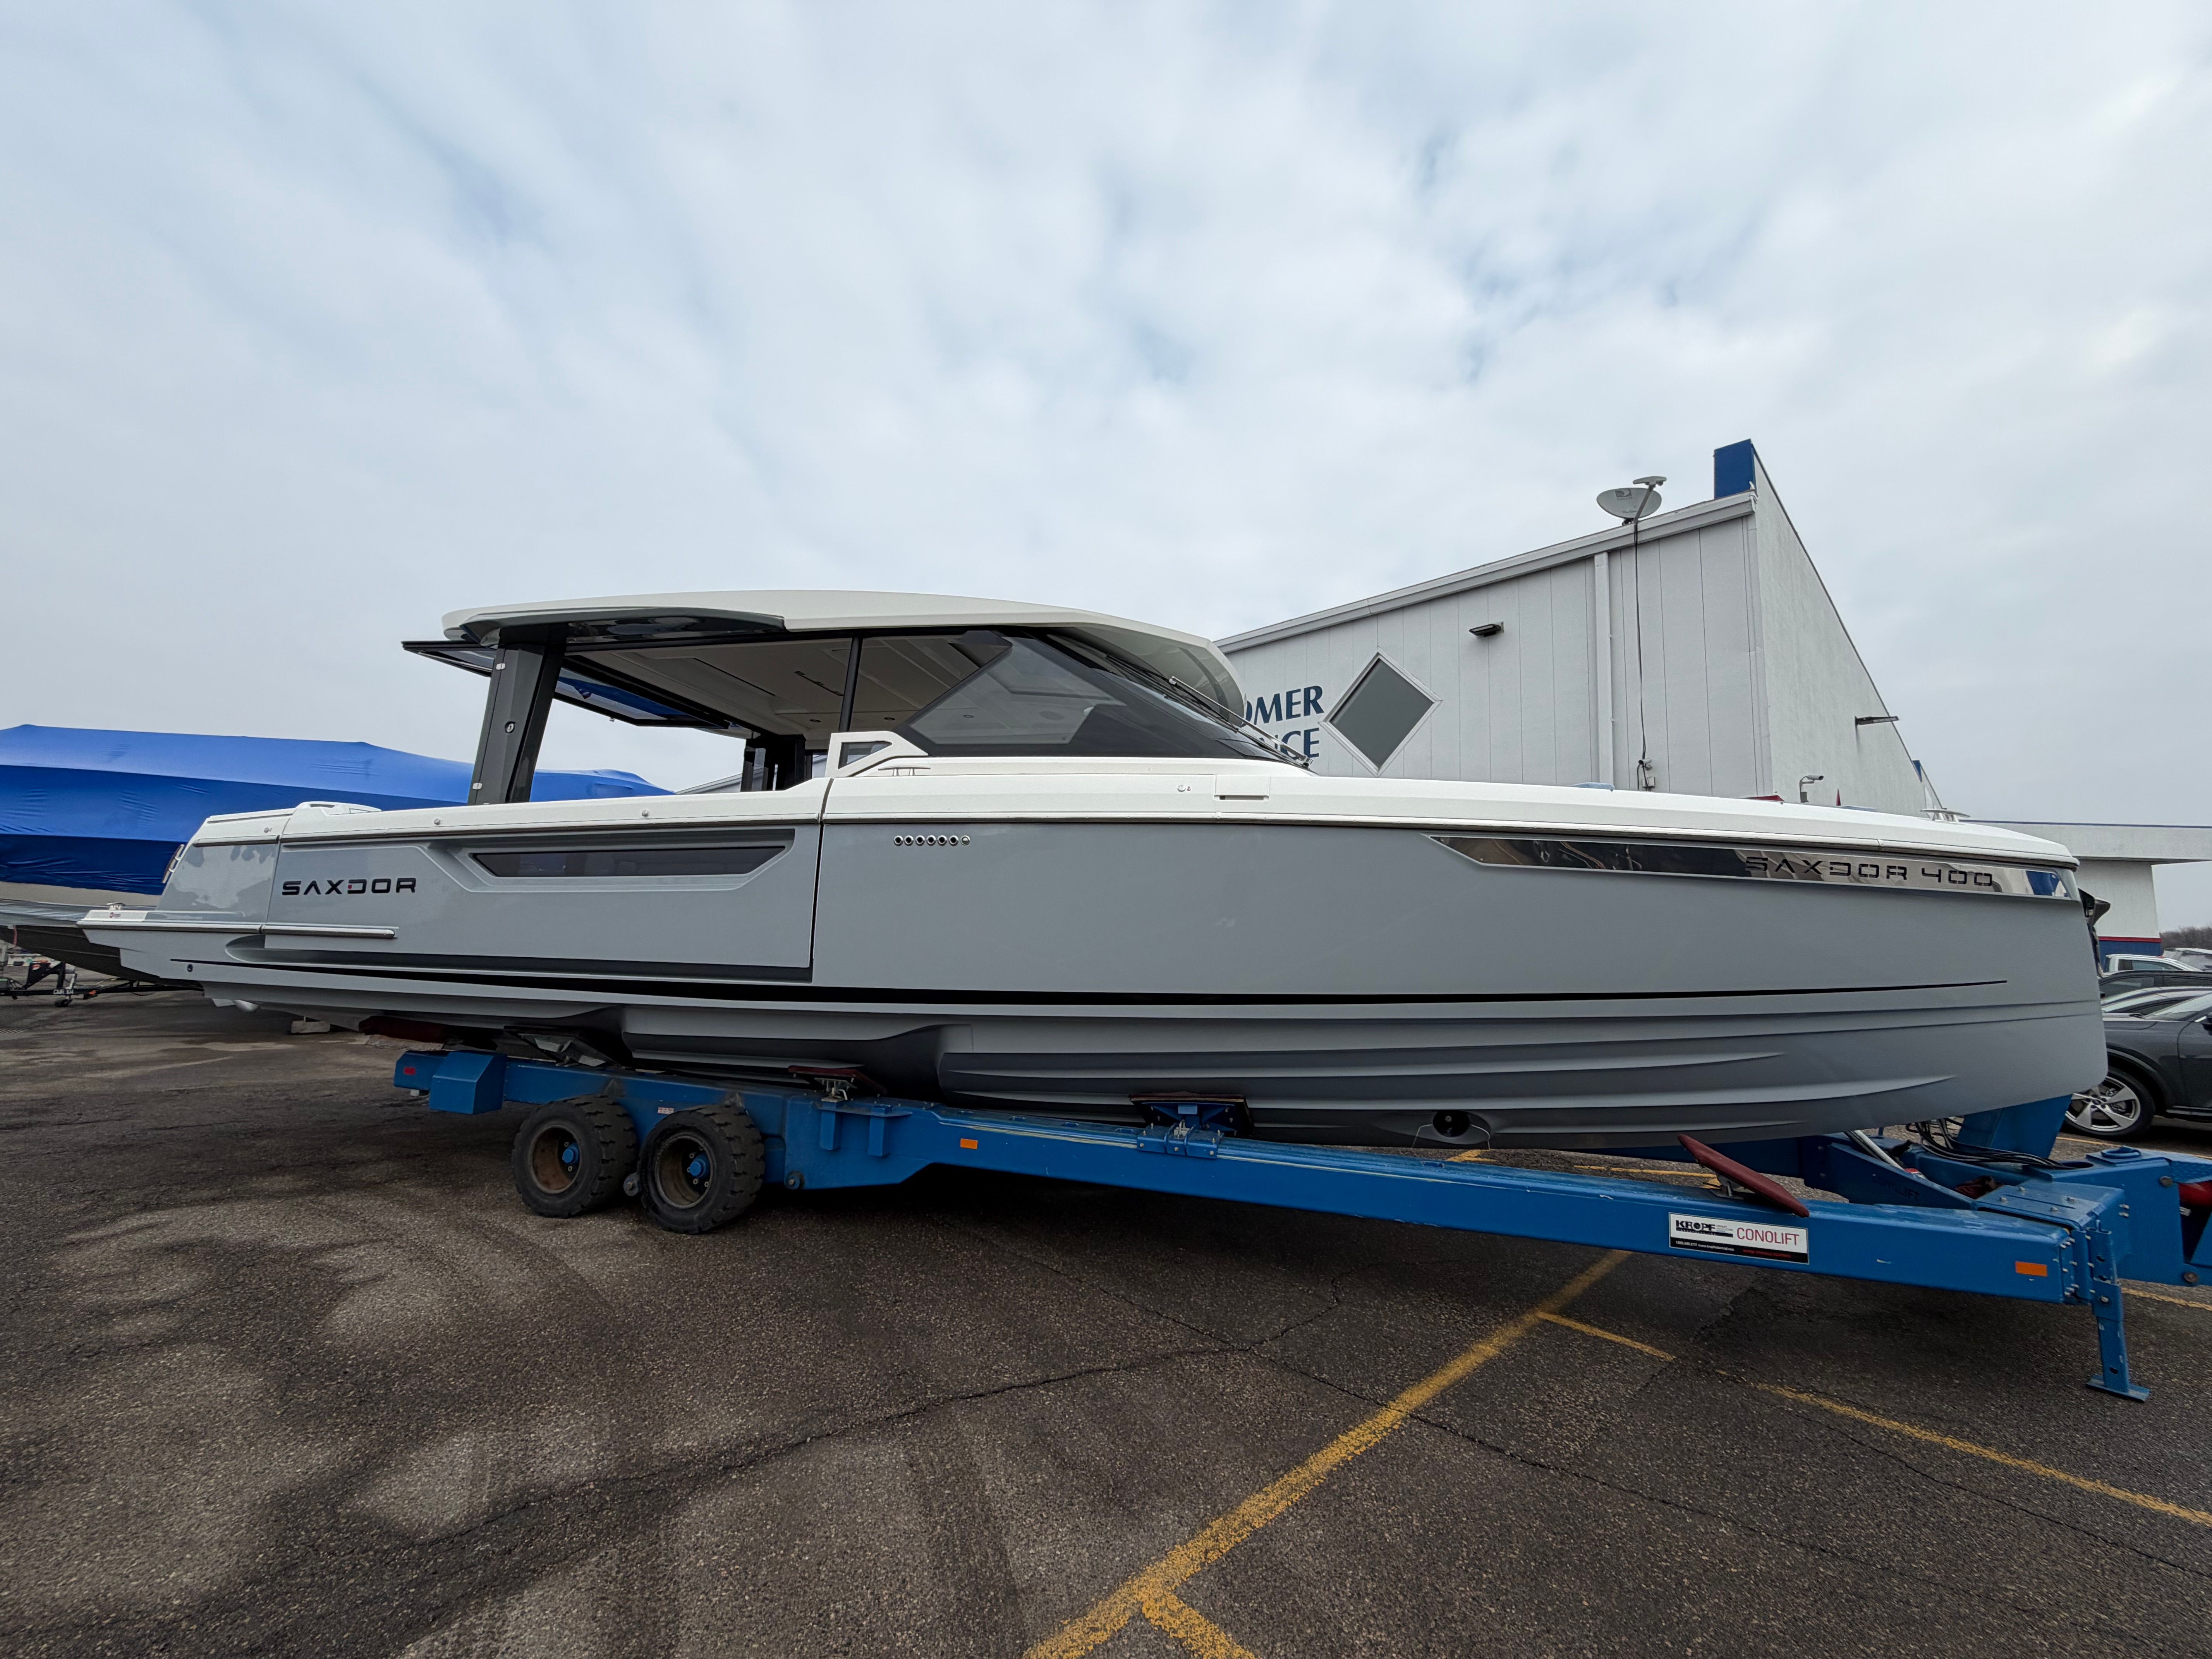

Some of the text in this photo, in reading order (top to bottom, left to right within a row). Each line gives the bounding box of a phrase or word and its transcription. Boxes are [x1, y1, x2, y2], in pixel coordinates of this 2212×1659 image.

[1745, 857, 1992, 887] SAXDOR 400
[282, 878, 416, 896] SAXDOR
[1676, 1219, 1716, 1231] KROPF
[1737, 1227, 1800, 1246] CONOLIFT
